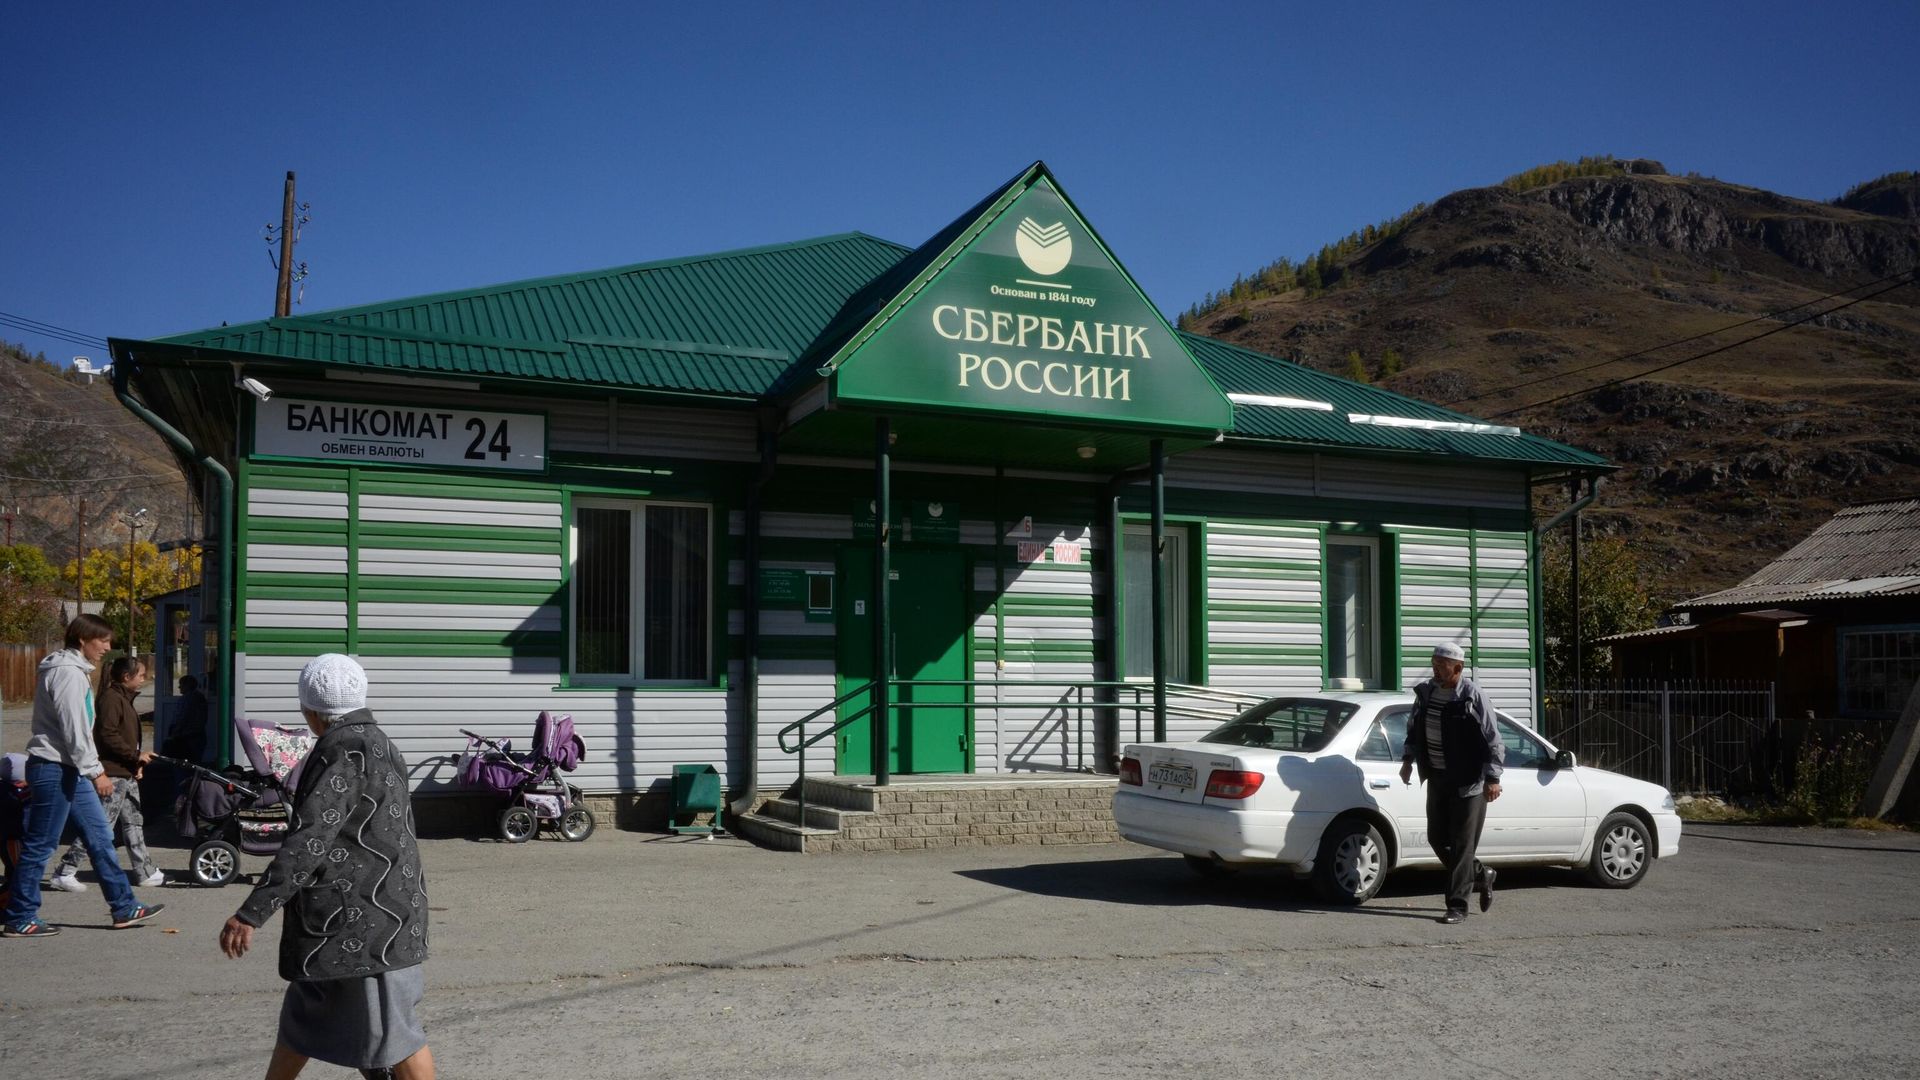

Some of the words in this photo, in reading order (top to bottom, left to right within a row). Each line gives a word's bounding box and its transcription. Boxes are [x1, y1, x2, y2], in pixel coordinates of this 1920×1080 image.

[991, 285, 1037, 299] Основан
[1040, 292, 1047, 300] в
[1049, 291, 1069, 303] 1841
[1072, 295, 1096, 307] году
[932, 304, 1151, 359] СБЕРБАНК
[958, 353, 1132, 401] РОССИИ
[287, 403, 453, 440] БАНКОМАТ
[464, 417, 511, 461] 24
[321, 442, 365, 456] ОБМЕН
[369, 445, 424, 459] ВАЛЮТЫ
